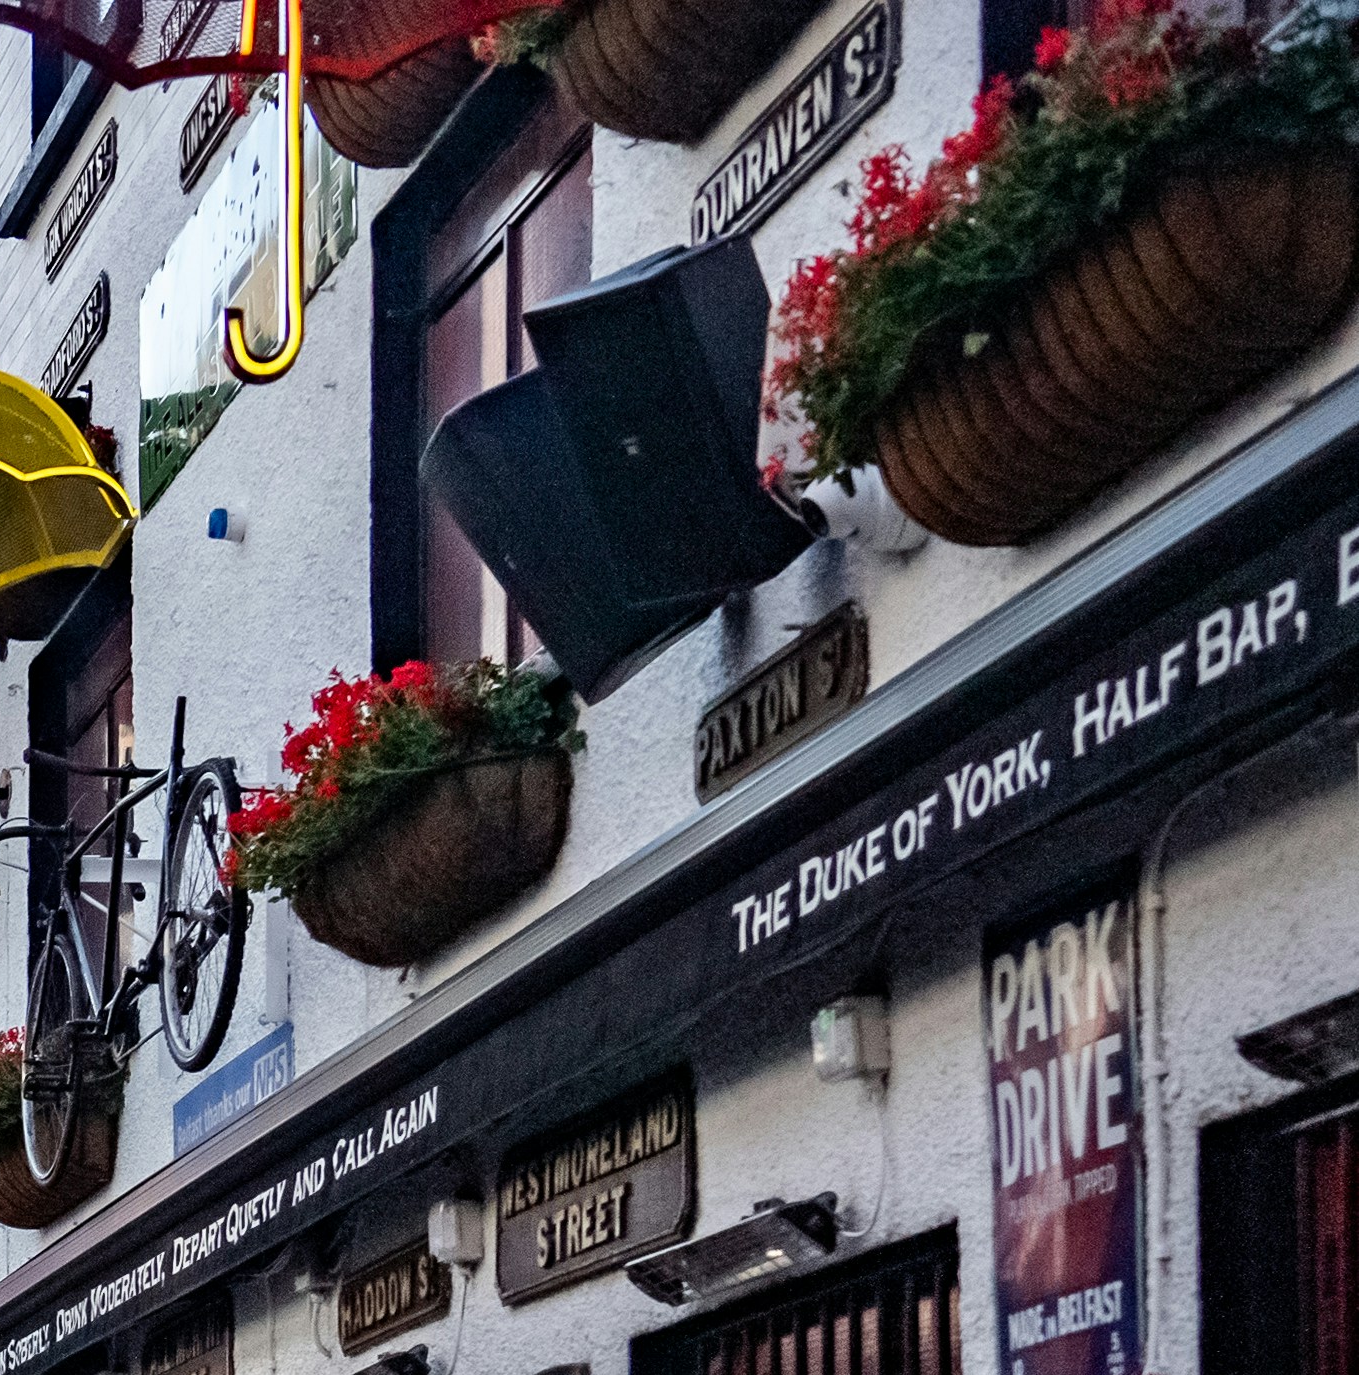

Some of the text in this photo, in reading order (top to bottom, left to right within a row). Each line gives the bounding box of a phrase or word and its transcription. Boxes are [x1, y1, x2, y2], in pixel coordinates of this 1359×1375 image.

[693, 64, 831, 245] DUNRAVEN
[696, 661, 801, 786] PAXTON
[731, 578, 1307, 953] THE DUKE OF YORK, HALF BAP,
[991, 901, 1121, 1064] PARK
[255, 1045, 287, 1104] NHS
[996, 1033, 1128, 1187] DRIVE
[55, 1297, 88, 1342] DRINK
[90, 1251, 165, 1323] MODERATELY,
[172, 1217, 226, 1275] DEPART
[226, 1179, 286, 1244] QUIETLY
[292, 1157, 326, 1207] AND
[332, 1127, 375, 1180] CALL
[377, 1086, 439, 1154] AGAIN
[537, 1185, 624, 1267] STREET
[1058, 1279, 1123, 1336] BELFAST
